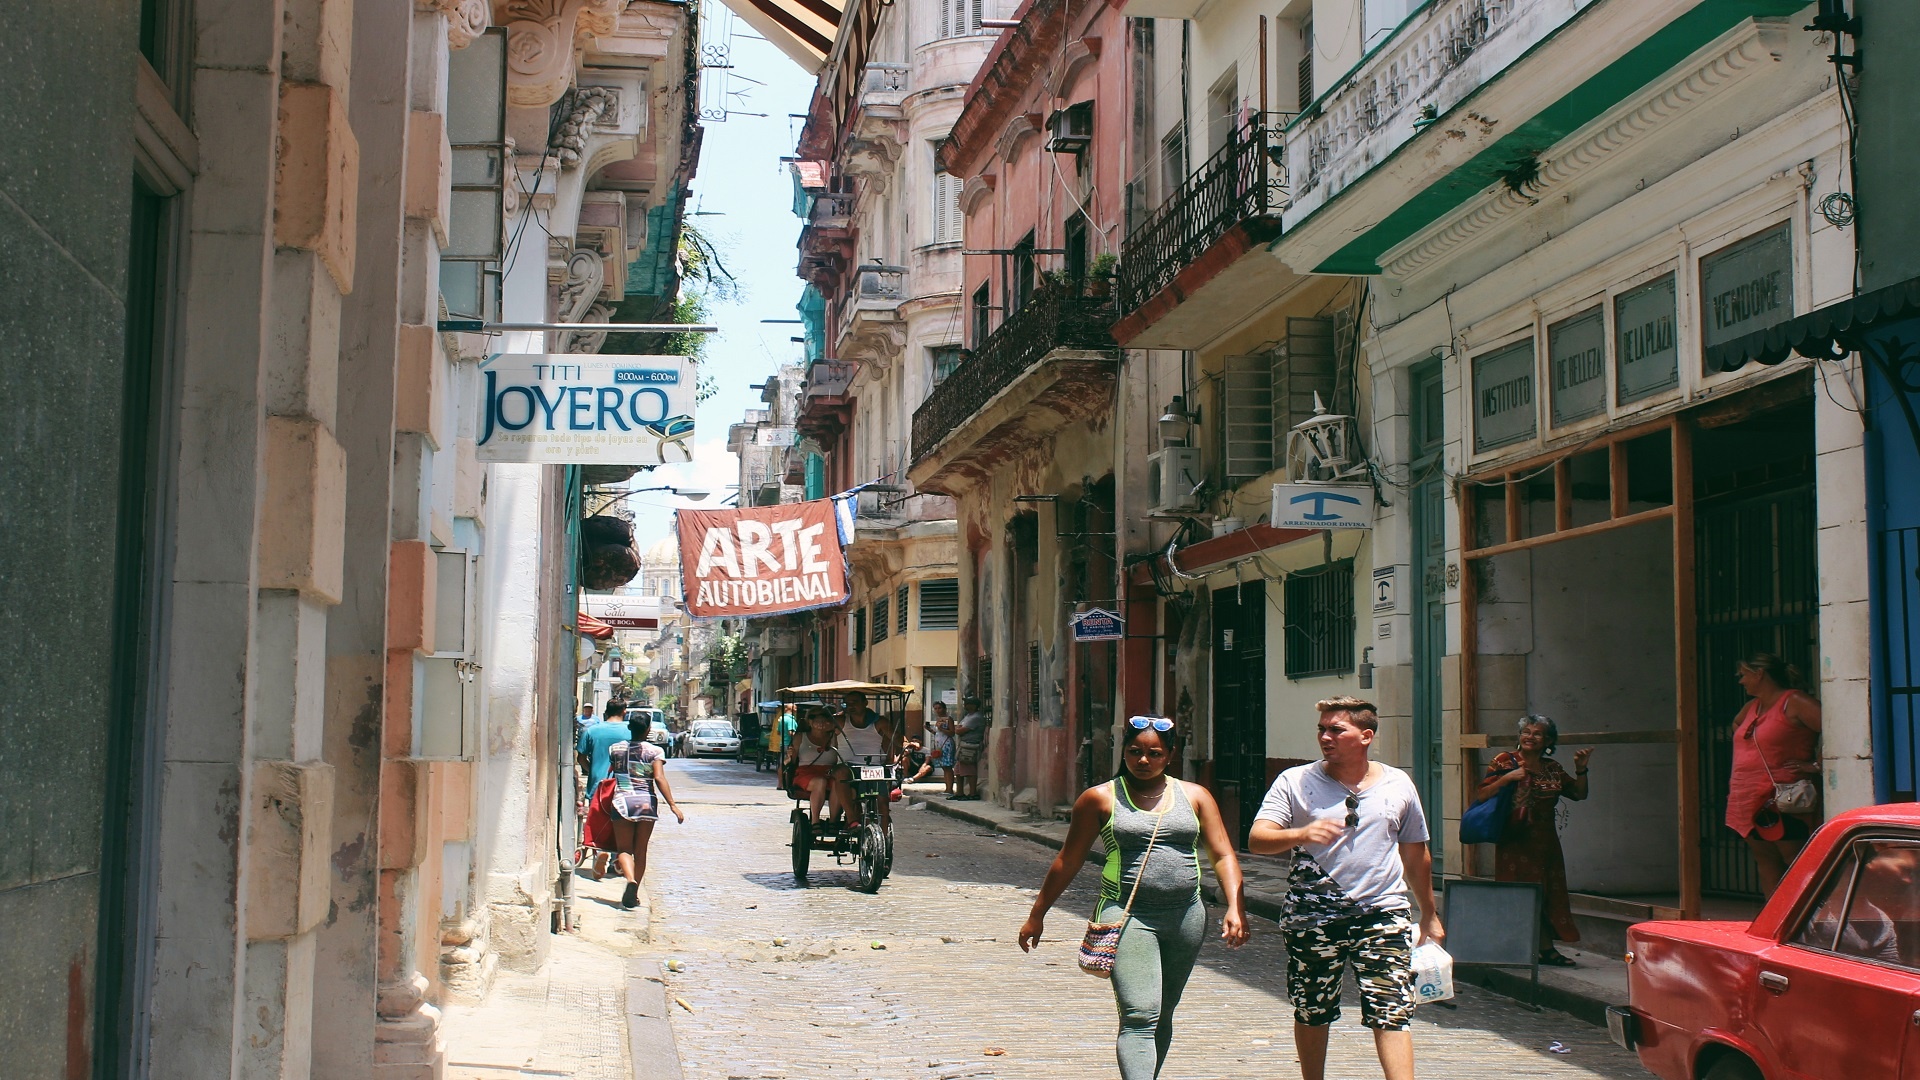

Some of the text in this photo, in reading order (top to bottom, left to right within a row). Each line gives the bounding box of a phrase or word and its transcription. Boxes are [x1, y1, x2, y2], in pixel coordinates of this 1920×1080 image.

[1713, 270, 1781, 330] VENDOME
[1623, 316, 1672, 364] DE LA PLAZA
[532, 365, 580, 380] TITI
[617, 372, 644, 381] 9.00AM
[650, 373, 677, 381] 6.00PM
[1556, 348, 1602, 391] DE BELLEZA
[478, 371, 669, 447] JOYERO
[1482, 375, 1530, 418] INSTITUTO
[497, 432, 509, 441] Se
[511, 434, 548, 444] reparan
[551, 433, 571, 442] todo
[574, 434, 593, 444] tipo
[594, 434, 606, 443] de
[608, 434, 634, 445] joyas
[566, 446, 573, 456] y
[575, 444, 600, 456] plata
[696, 518, 830, 578] ARTE
[696, 572, 839, 607] AUTOBIENAL
[604, 608, 626, 617] Gala
[862, 769, 883, 778] TAXI
